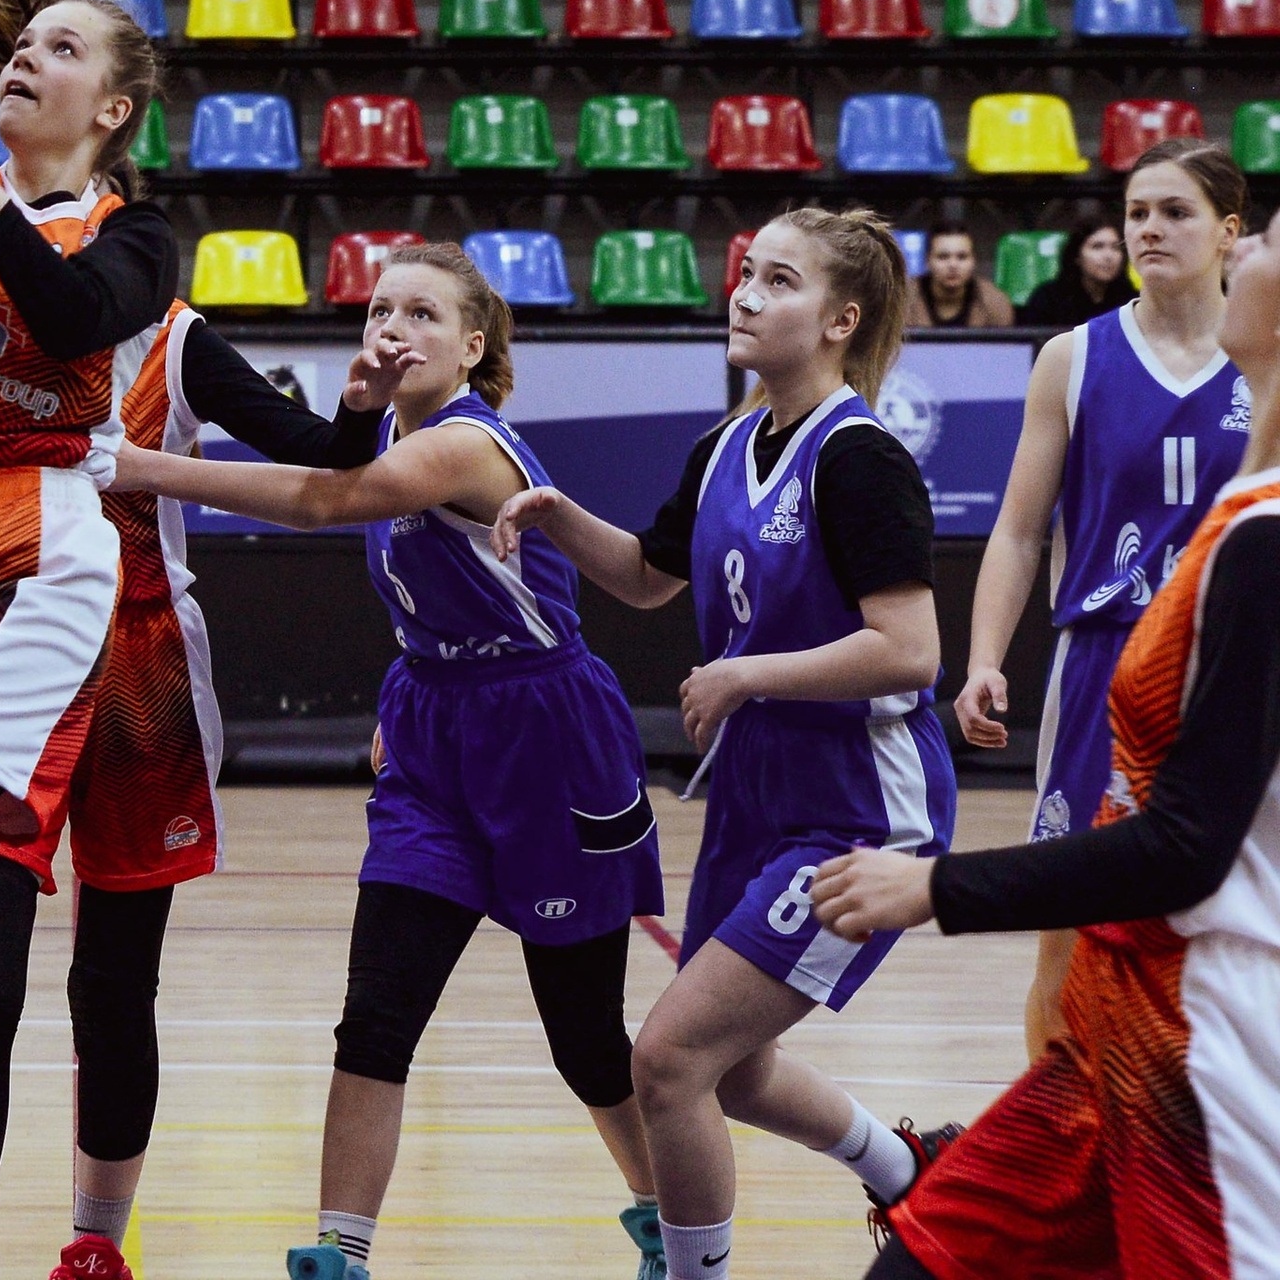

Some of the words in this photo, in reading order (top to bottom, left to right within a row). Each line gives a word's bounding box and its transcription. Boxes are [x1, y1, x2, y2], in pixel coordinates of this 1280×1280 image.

[1163, 437, 1196, 505] 11
[724, 548, 751, 623] 8
[767, 865, 819, 935] 8
